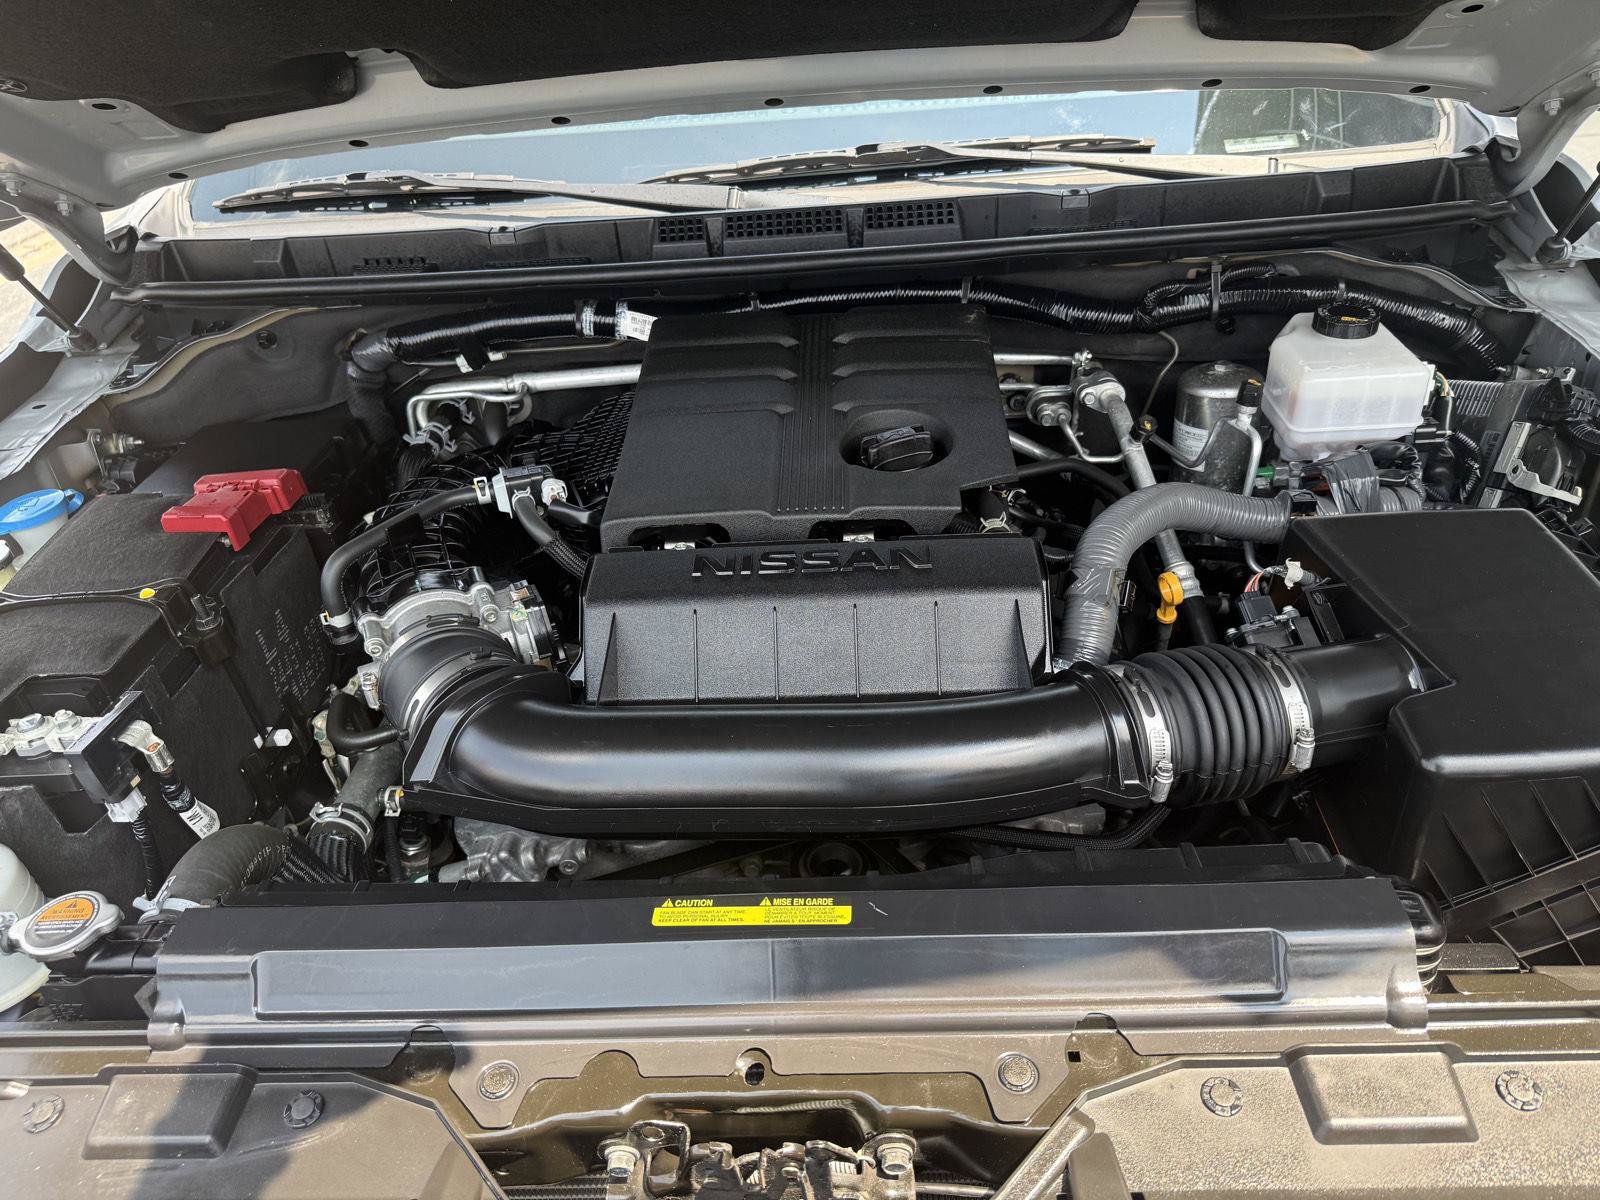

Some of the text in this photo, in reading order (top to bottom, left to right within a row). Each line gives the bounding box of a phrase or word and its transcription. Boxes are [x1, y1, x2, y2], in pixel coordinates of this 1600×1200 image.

[691, 545, 934, 577] NISSAN
[674, 898, 714, 907] CAUTION
[773, 897, 834, 906] MISE EN GARDE
